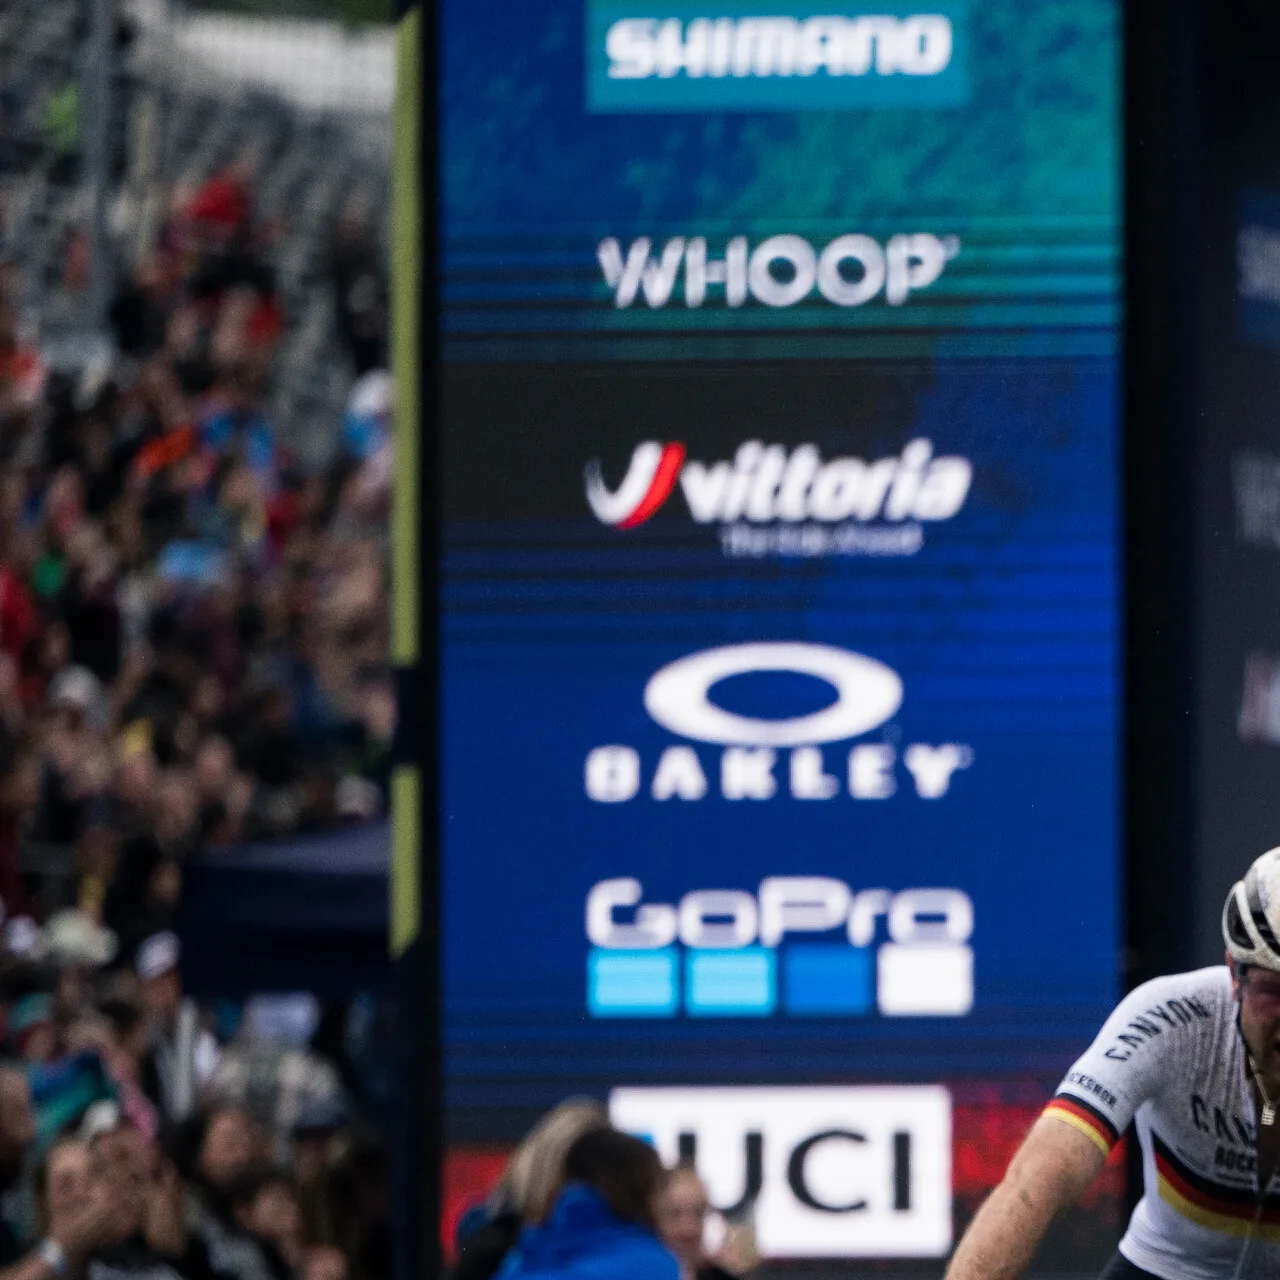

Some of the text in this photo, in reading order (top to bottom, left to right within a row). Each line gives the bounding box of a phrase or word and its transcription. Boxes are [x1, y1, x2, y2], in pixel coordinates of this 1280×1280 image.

[605, 15, 954, 80] SHIMANO
[597, 232, 955, 309] WHOOP
[681, 438, 972, 523] vittoria
[585, 743, 966, 803] OAKLEY
[586, 875, 974, 948] GoPro
[1104, 995, 1211, 1062] CANYON
[677, 1130, 912, 1214] UCI
